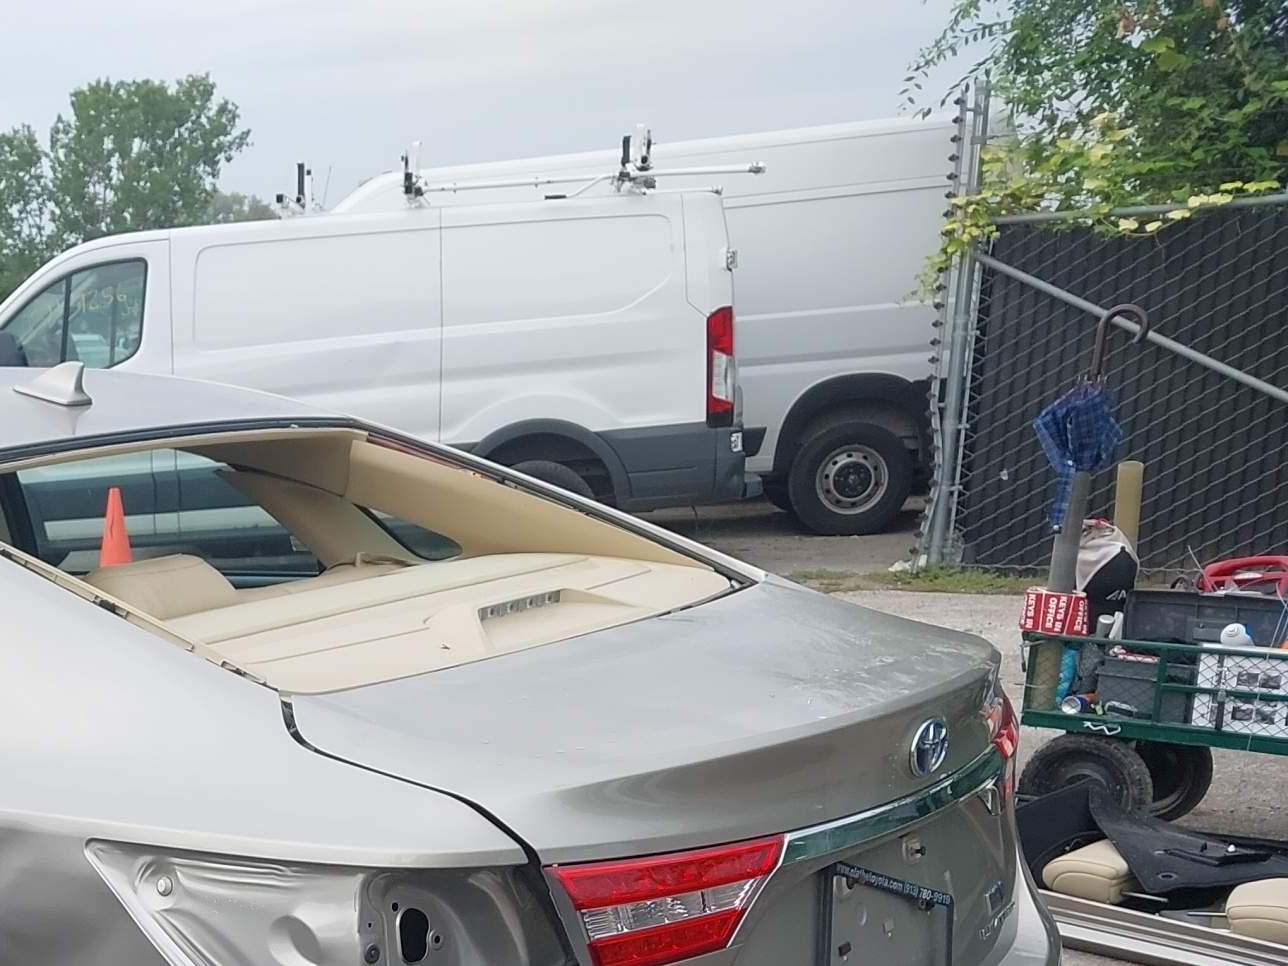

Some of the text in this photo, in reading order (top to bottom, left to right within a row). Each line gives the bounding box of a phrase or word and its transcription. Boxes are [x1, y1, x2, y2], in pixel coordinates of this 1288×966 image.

[1045, 597, 1058, 629] OFFICE
[1053, 595, 1068, 632] KEYS IN
[1073, 600, 1085, 632] OFFICE
